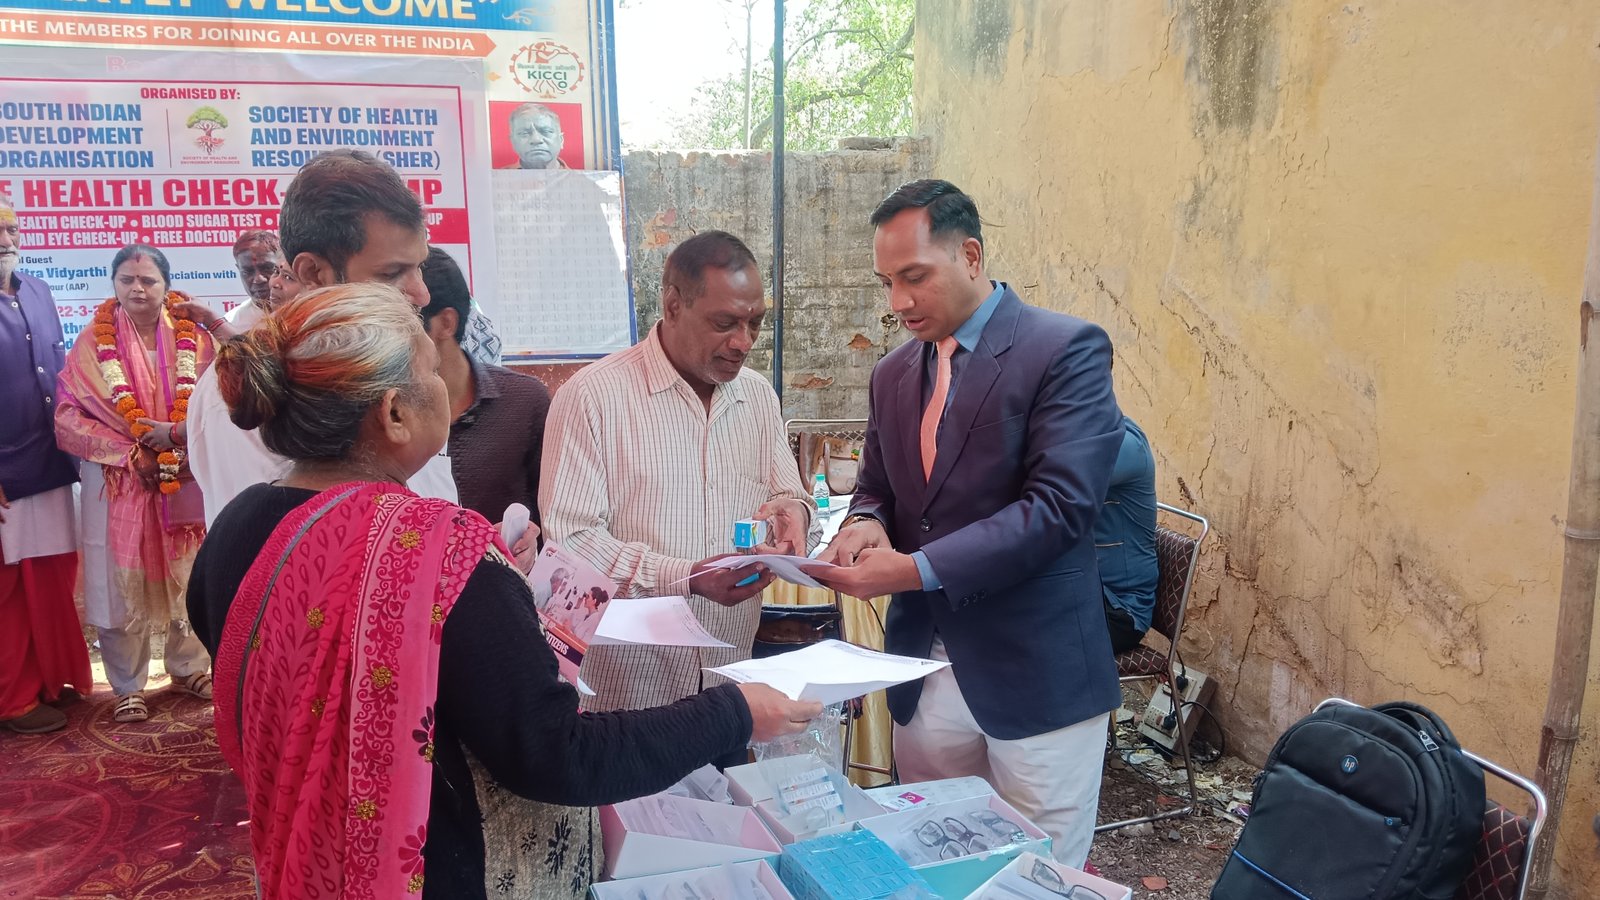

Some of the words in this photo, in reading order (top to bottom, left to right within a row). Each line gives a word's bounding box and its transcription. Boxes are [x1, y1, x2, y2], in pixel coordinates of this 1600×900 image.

[0, 18, 38, 34] THE
[45, 21, 147, 38] MEMBERS
[153, 26, 192, 40] FOR
[198, 27, 280, 43] JOINING
[286, 30, 321, 45] ALL
[326, 32, 376, 47] OVER
[381, 35, 417, 49] THE
[422, 36, 475, 50] INDIA
[527, 70, 567, 81] KICCI
[140, 87, 217, 100] ORGANISED
[219, 88, 241, 100] BY:
[0, 102, 62, 120] OUTH
[67, 103, 142, 121] INDIAN
[248, 105, 332, 124] SOCIETY
[337, 107, 362, 124] OF
[366, 107, 438, 126] HEALTH
[250, 128, 292, 145] AND
[296, 128, 435, 147] ENVIRONMENT
[23, 179, 153, 207] HEALTH
[162, 178, 285, 207] CHECK-
[60, 215, 126, 229] CHECK-UP
[142, 214, 184, 228] BLOOD
[186, 214, 230, 228] SUGAR
[231, 213, 262, 227] TEST
[20, 232, 46, 247] AND
[48, 232, 71, 246] EYE
[72, 231, 138, 245] CHECK-UP
[153, 230, 183, 244] FREE
[185, 229, 238, 243] DOCTOR
[25, 255, 53, 264] Guest
[46, 266, 107, 280] Vidyarthi
[170, 270, 211, 280] ociation
[213, 270, 237, 279] with
[65, 283, 89, 291] (AAP)
[1344, 757, 1356, 772] hp
